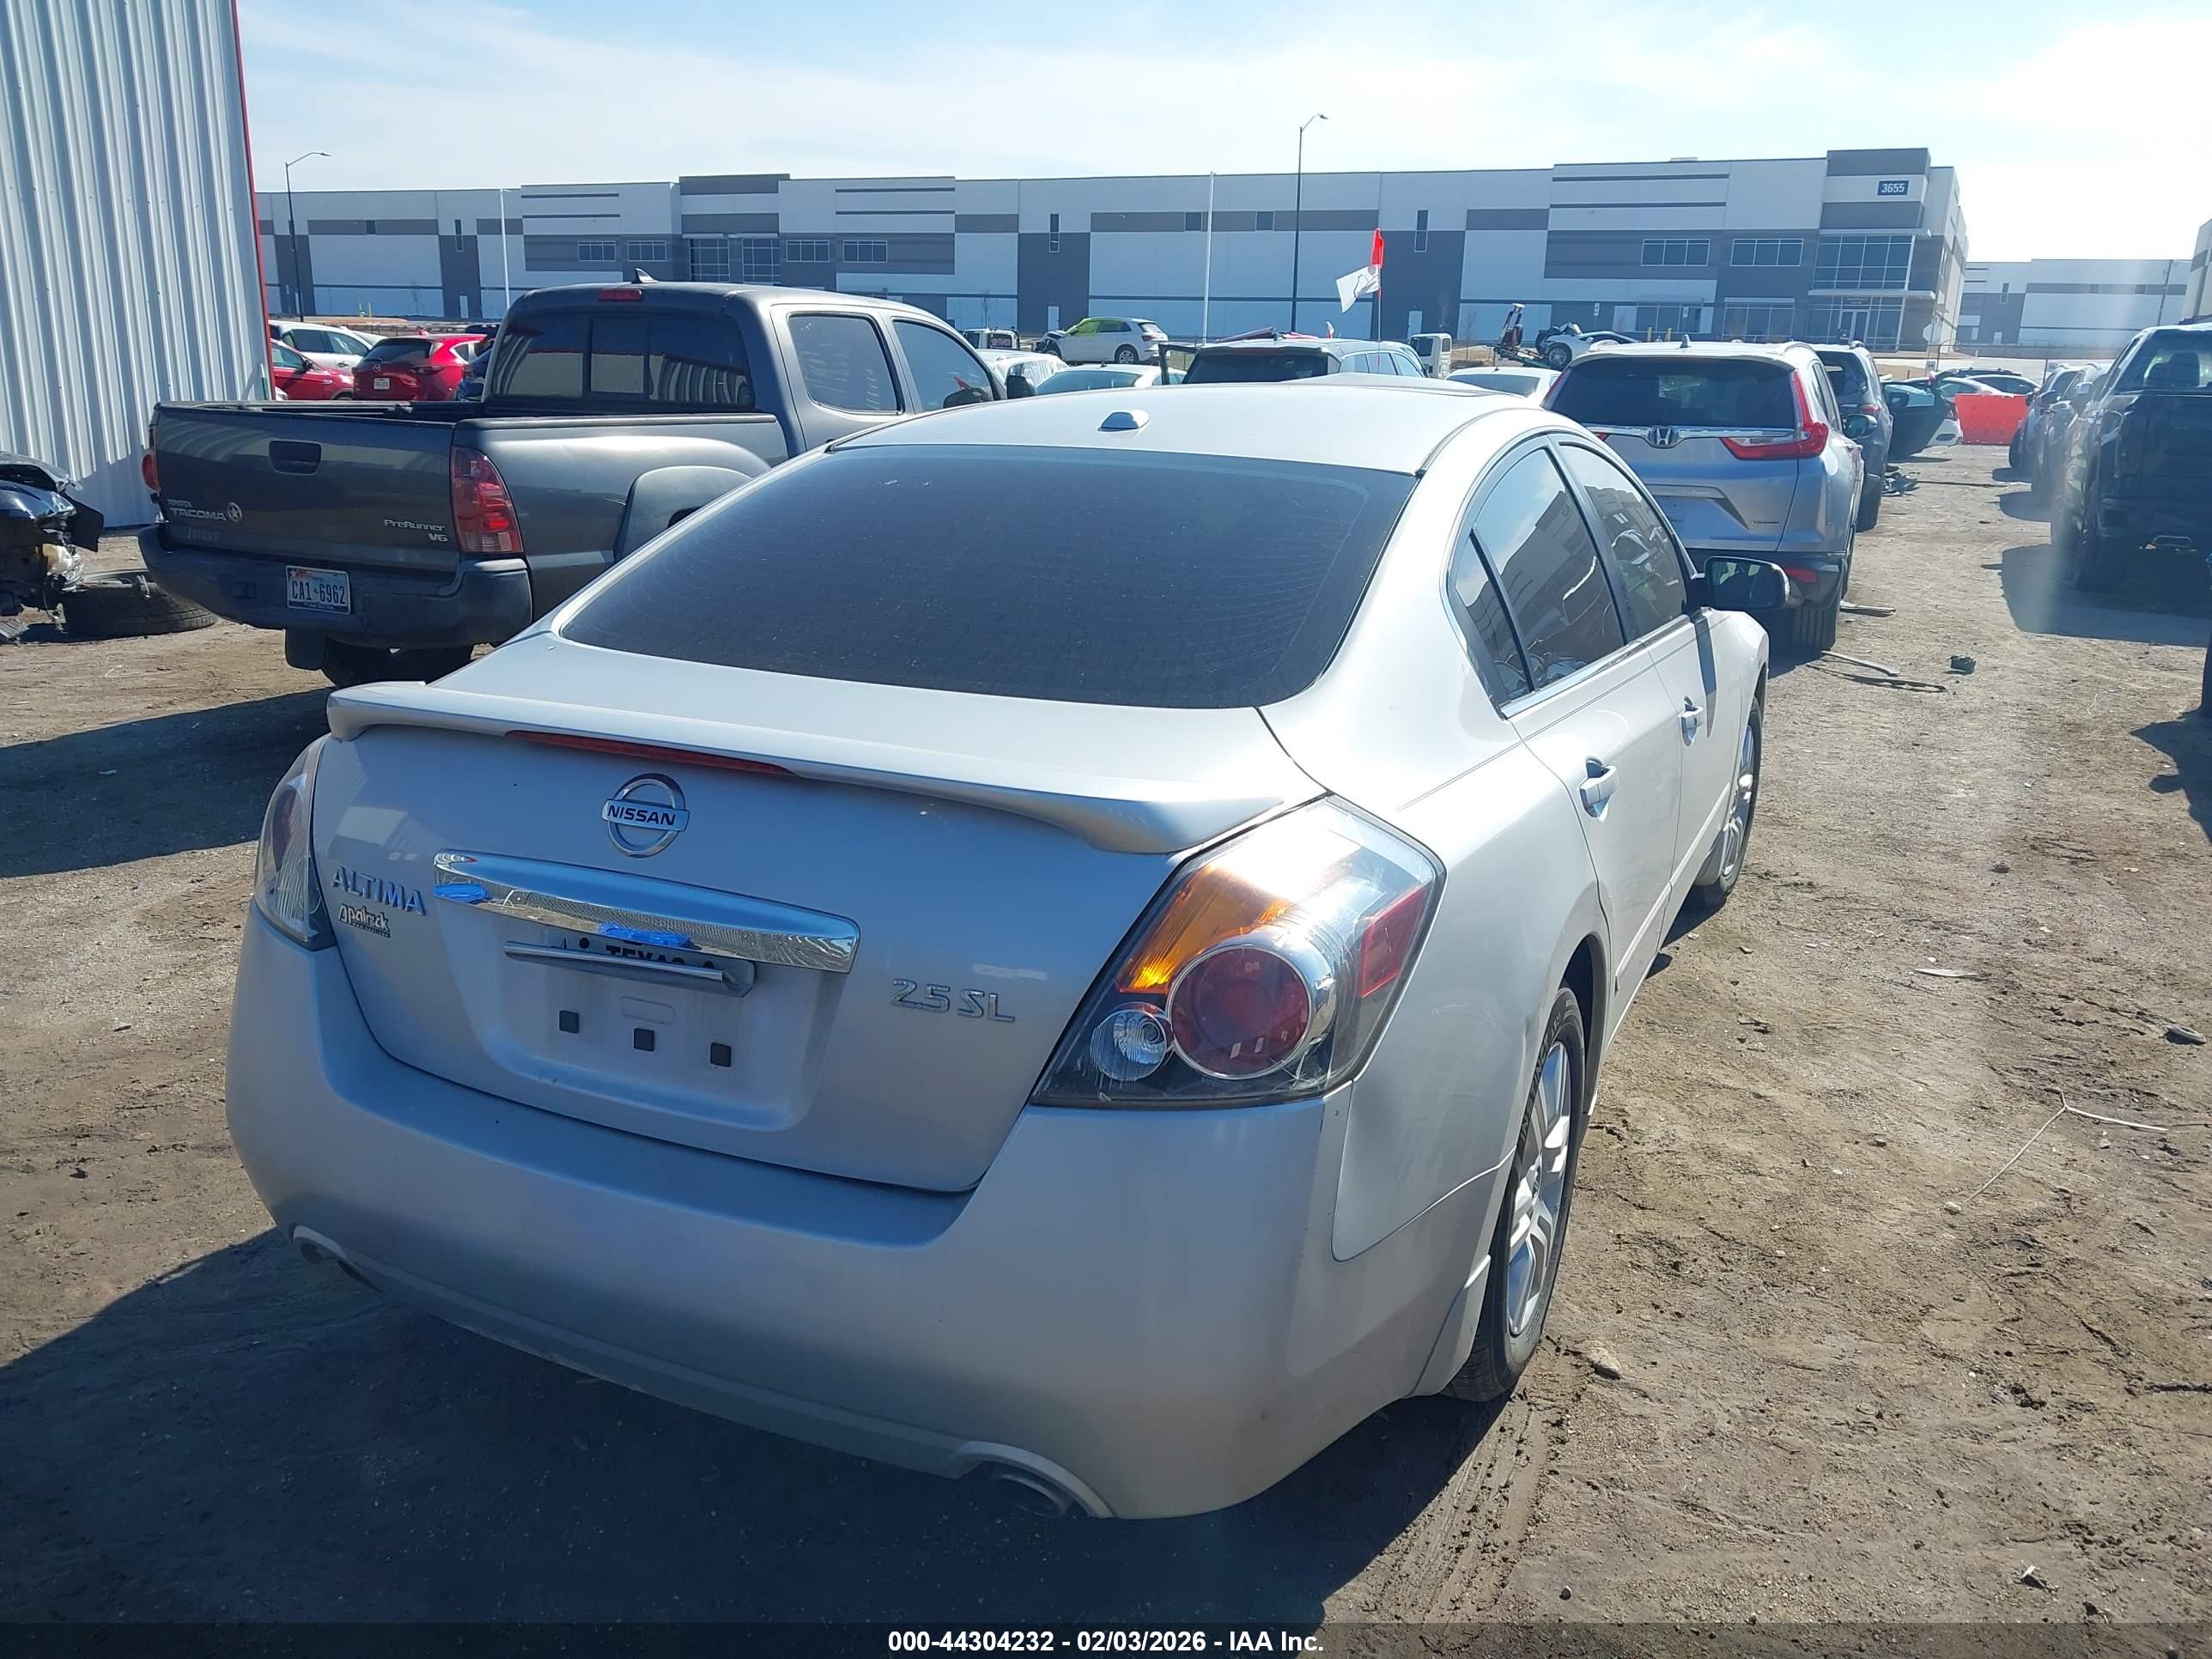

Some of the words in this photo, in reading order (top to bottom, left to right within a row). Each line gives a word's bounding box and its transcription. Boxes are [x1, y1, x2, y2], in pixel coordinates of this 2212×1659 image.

[1881, 183, 1905, 193] 3655
[170, 507, 228, 521] TACOMA
[384, 519, 446, 531] PreRunner
[428, 532, 448, 542] V6
[292, 580, 313, 600] CA1
[319, 583, 345, 605] 6962
[607, 805, 676, 826] NISSAN
[331, 865, 426, 916] ALTIMA
[957, 989, 1016, 1024] SL
